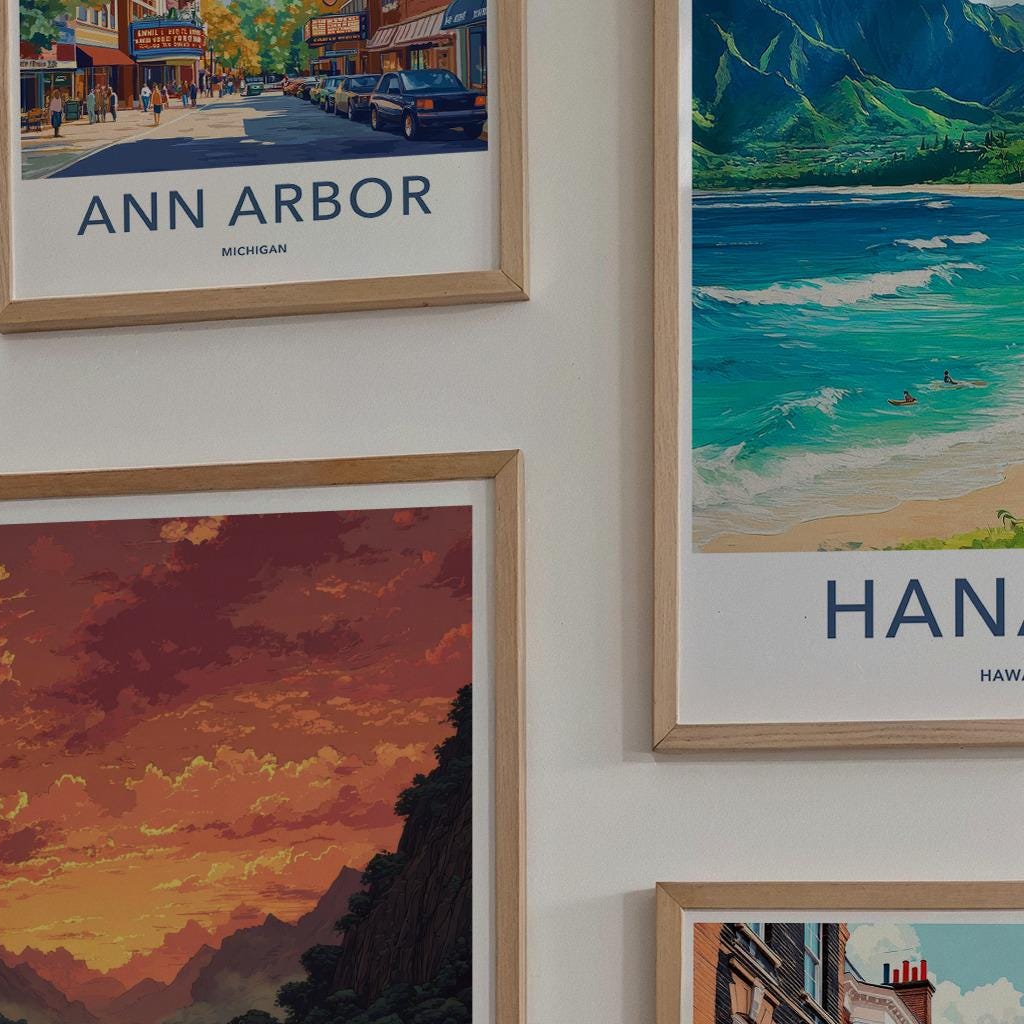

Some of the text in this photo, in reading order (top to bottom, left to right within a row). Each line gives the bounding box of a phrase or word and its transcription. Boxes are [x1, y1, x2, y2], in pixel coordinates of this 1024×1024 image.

[77, 174, 432, 236] ANN ARBOR
[221, 243, 287, 257] MICHIGAN
[827, 577, 1024, 639] HAN
[980, 668, 1024, 682] HAW
